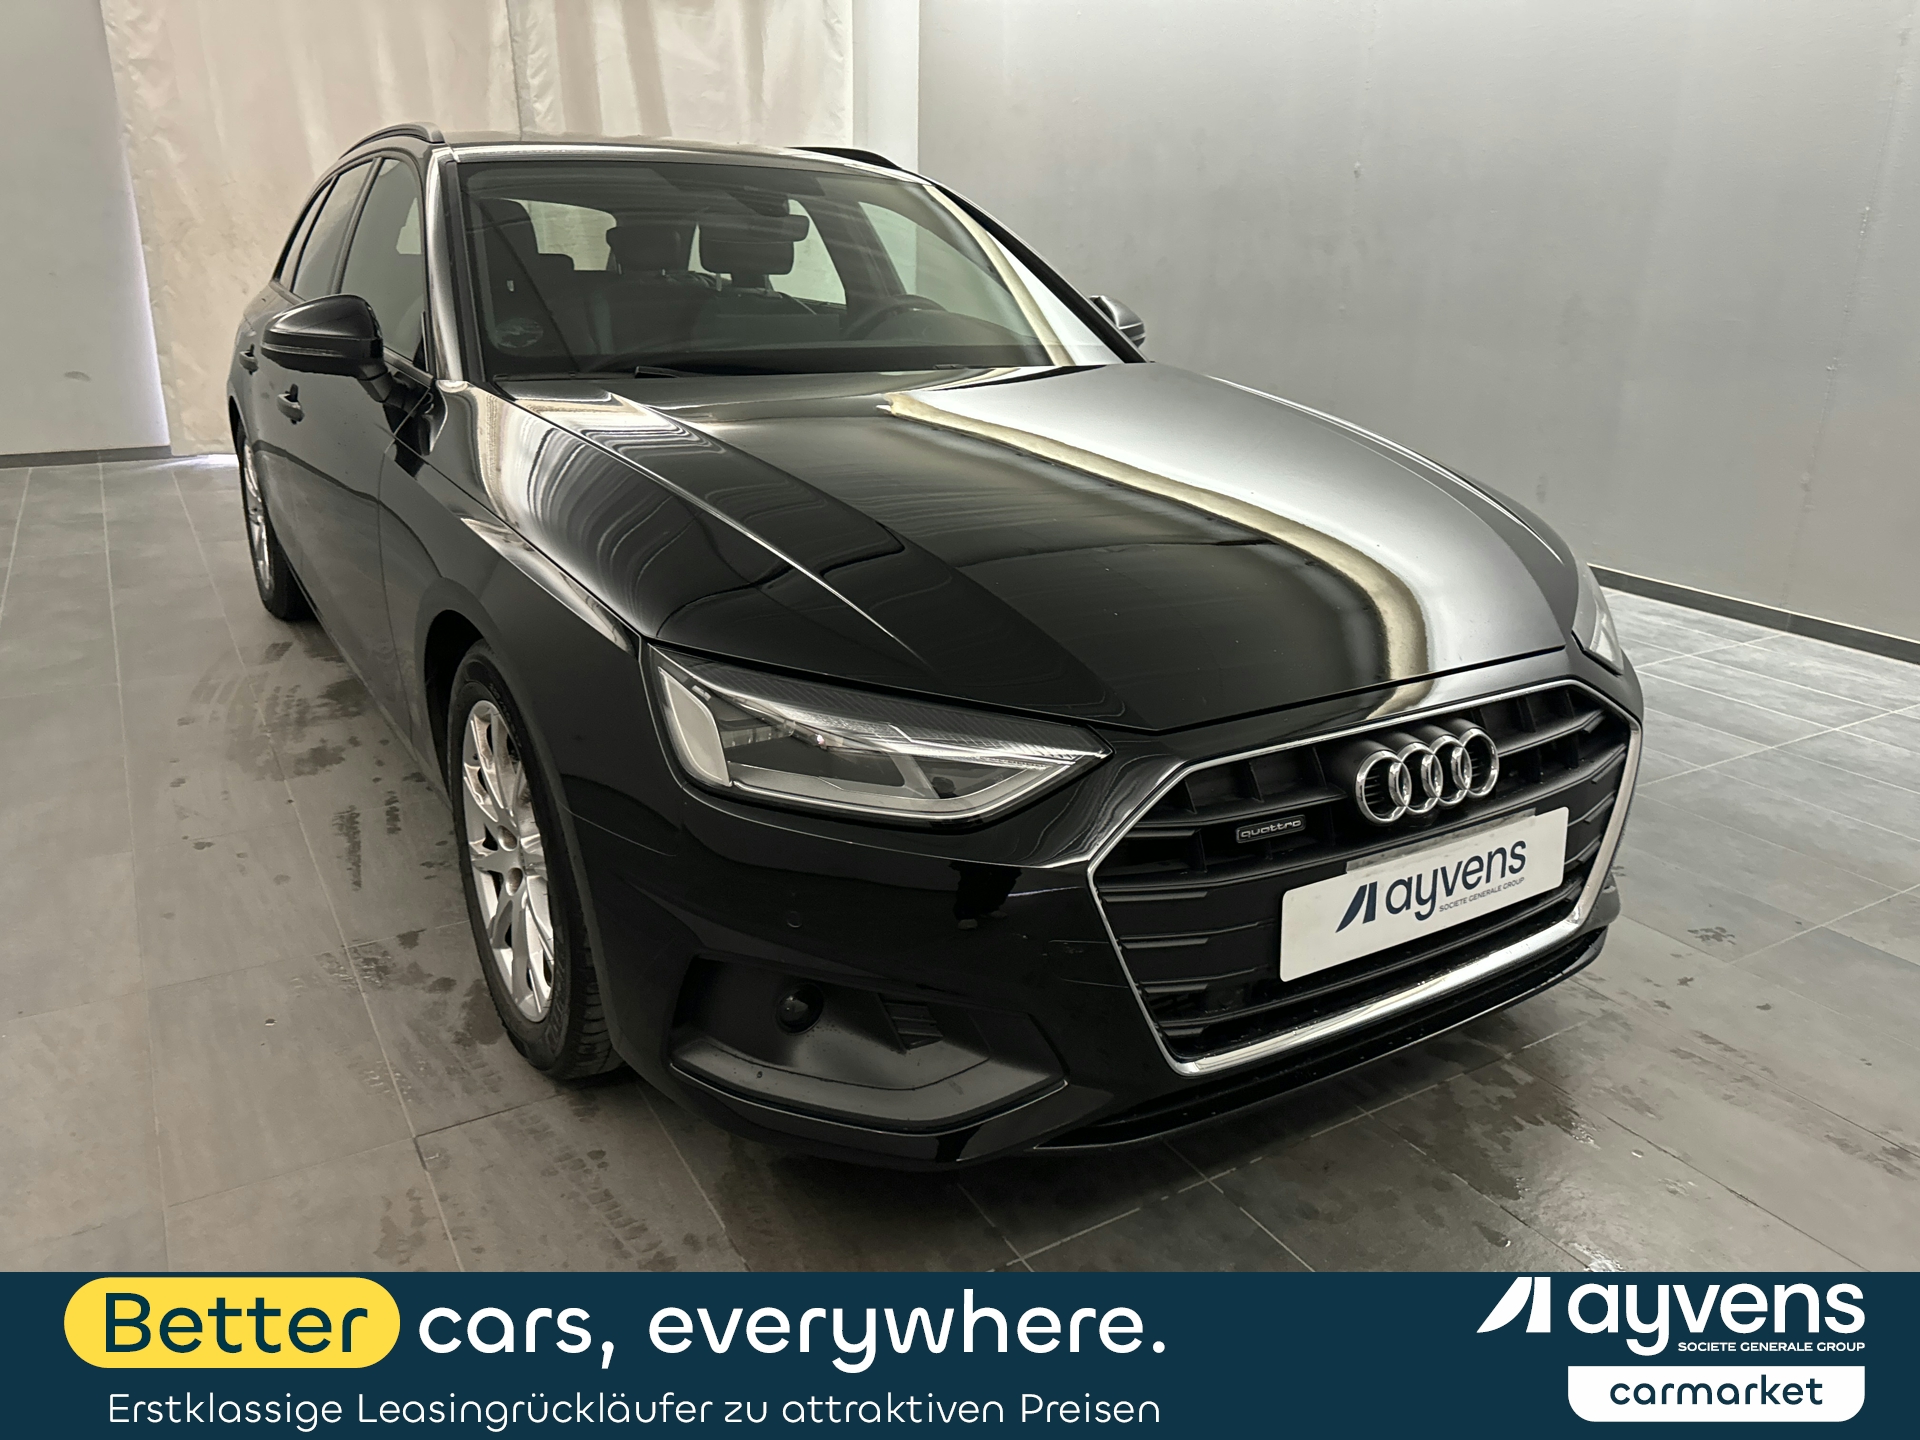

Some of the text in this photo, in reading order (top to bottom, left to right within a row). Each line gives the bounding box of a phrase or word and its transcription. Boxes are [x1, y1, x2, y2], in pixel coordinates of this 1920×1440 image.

[1240, 819, 1302, 839] quattro
[1384, 839, 1527, 921] ayvens
[1439, 876, 1525, 912] SOCIETE GENERALE GROUP
